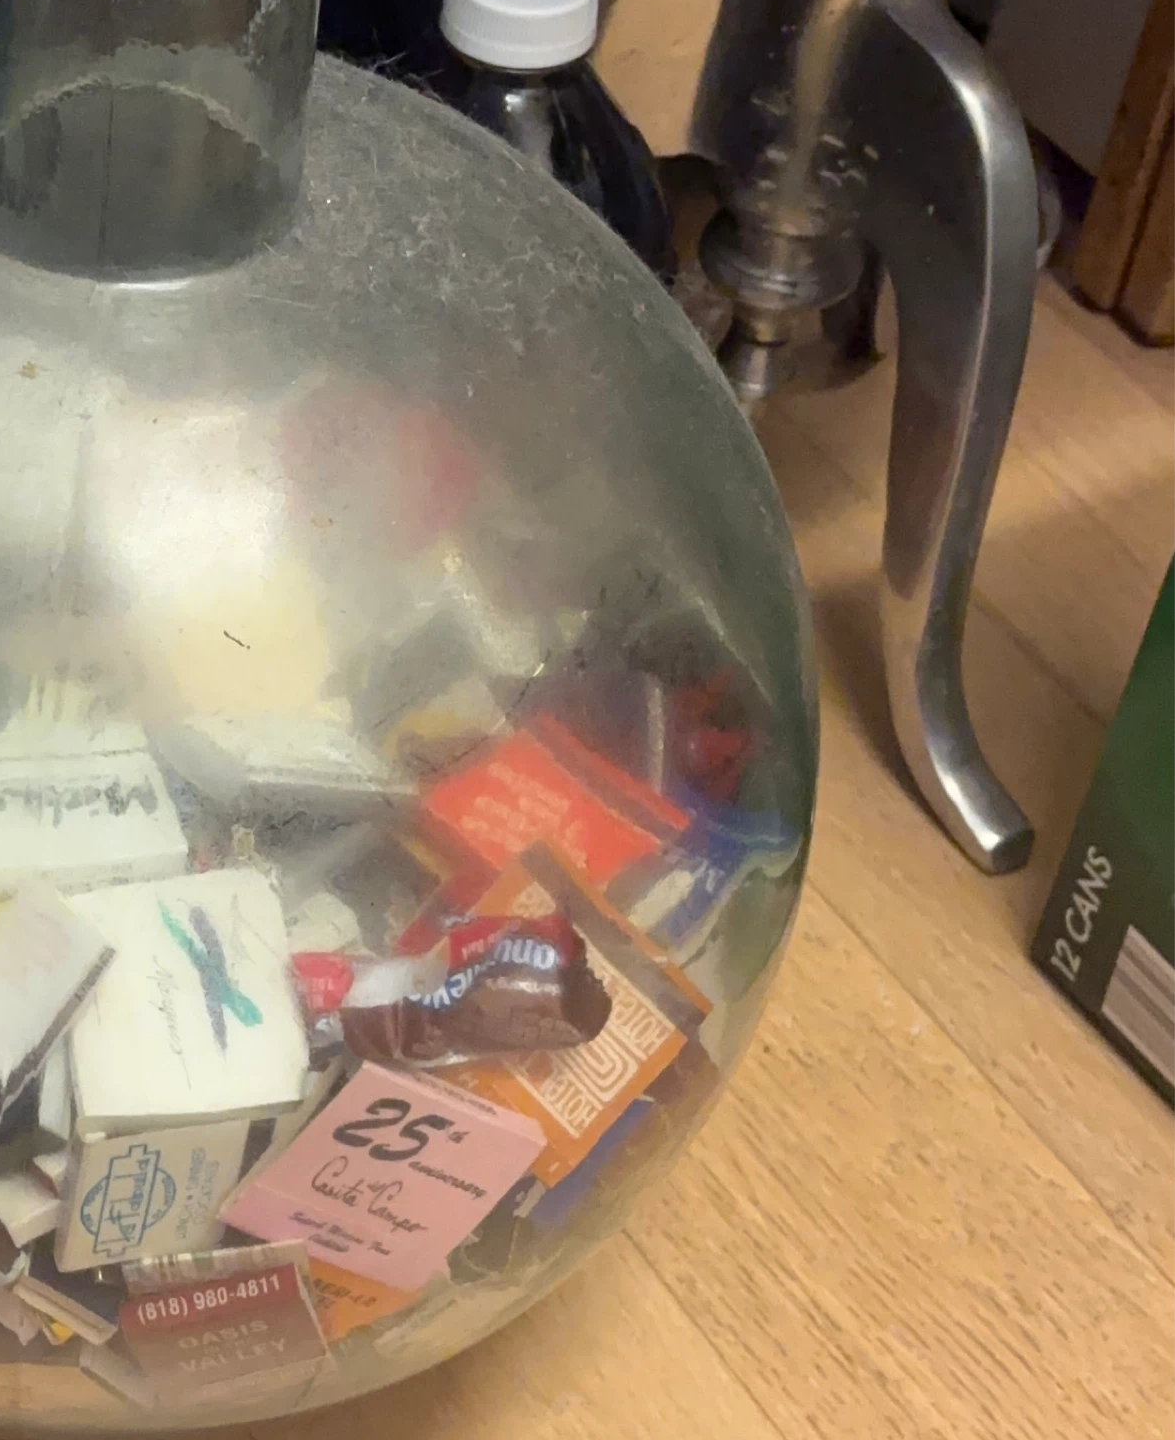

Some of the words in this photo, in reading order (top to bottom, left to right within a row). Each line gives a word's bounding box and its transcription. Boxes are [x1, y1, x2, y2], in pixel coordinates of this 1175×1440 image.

[1065, 845, 1114, 944] CANS
[1050, 938, 1081, 982] 12
[311, 1156, 366, 1207] Casita
[367, 1180, 430, 1234] Campo
[137, 1296, 189, 1326] (818)
[193, 1273, 281, 1310] 980-4811
[178, 1338, 288, 1372] VALLEY
[179, 1319, 269, 1349] OASIS
